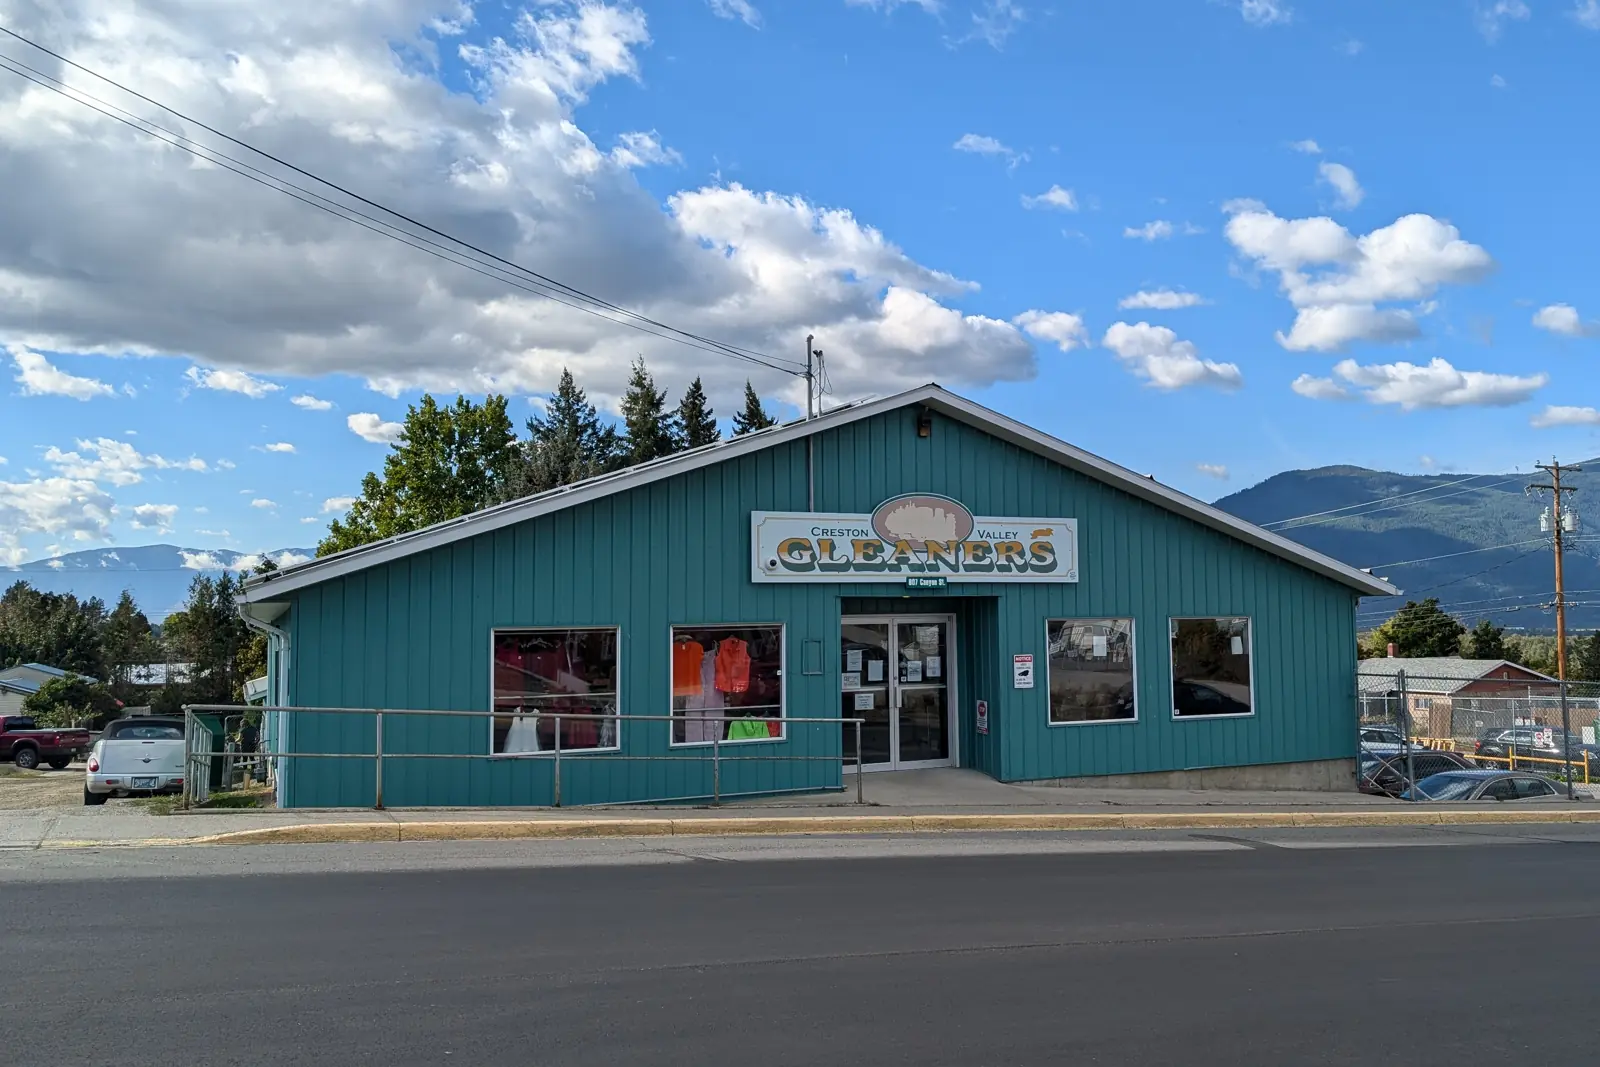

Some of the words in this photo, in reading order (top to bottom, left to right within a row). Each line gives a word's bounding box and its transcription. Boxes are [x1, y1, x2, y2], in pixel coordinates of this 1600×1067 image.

[811, 526, 869, 537] CRESTON
[977, 529, 1019, 540] VALLEY
[777, 538, 1058, 573] GLEANERS
